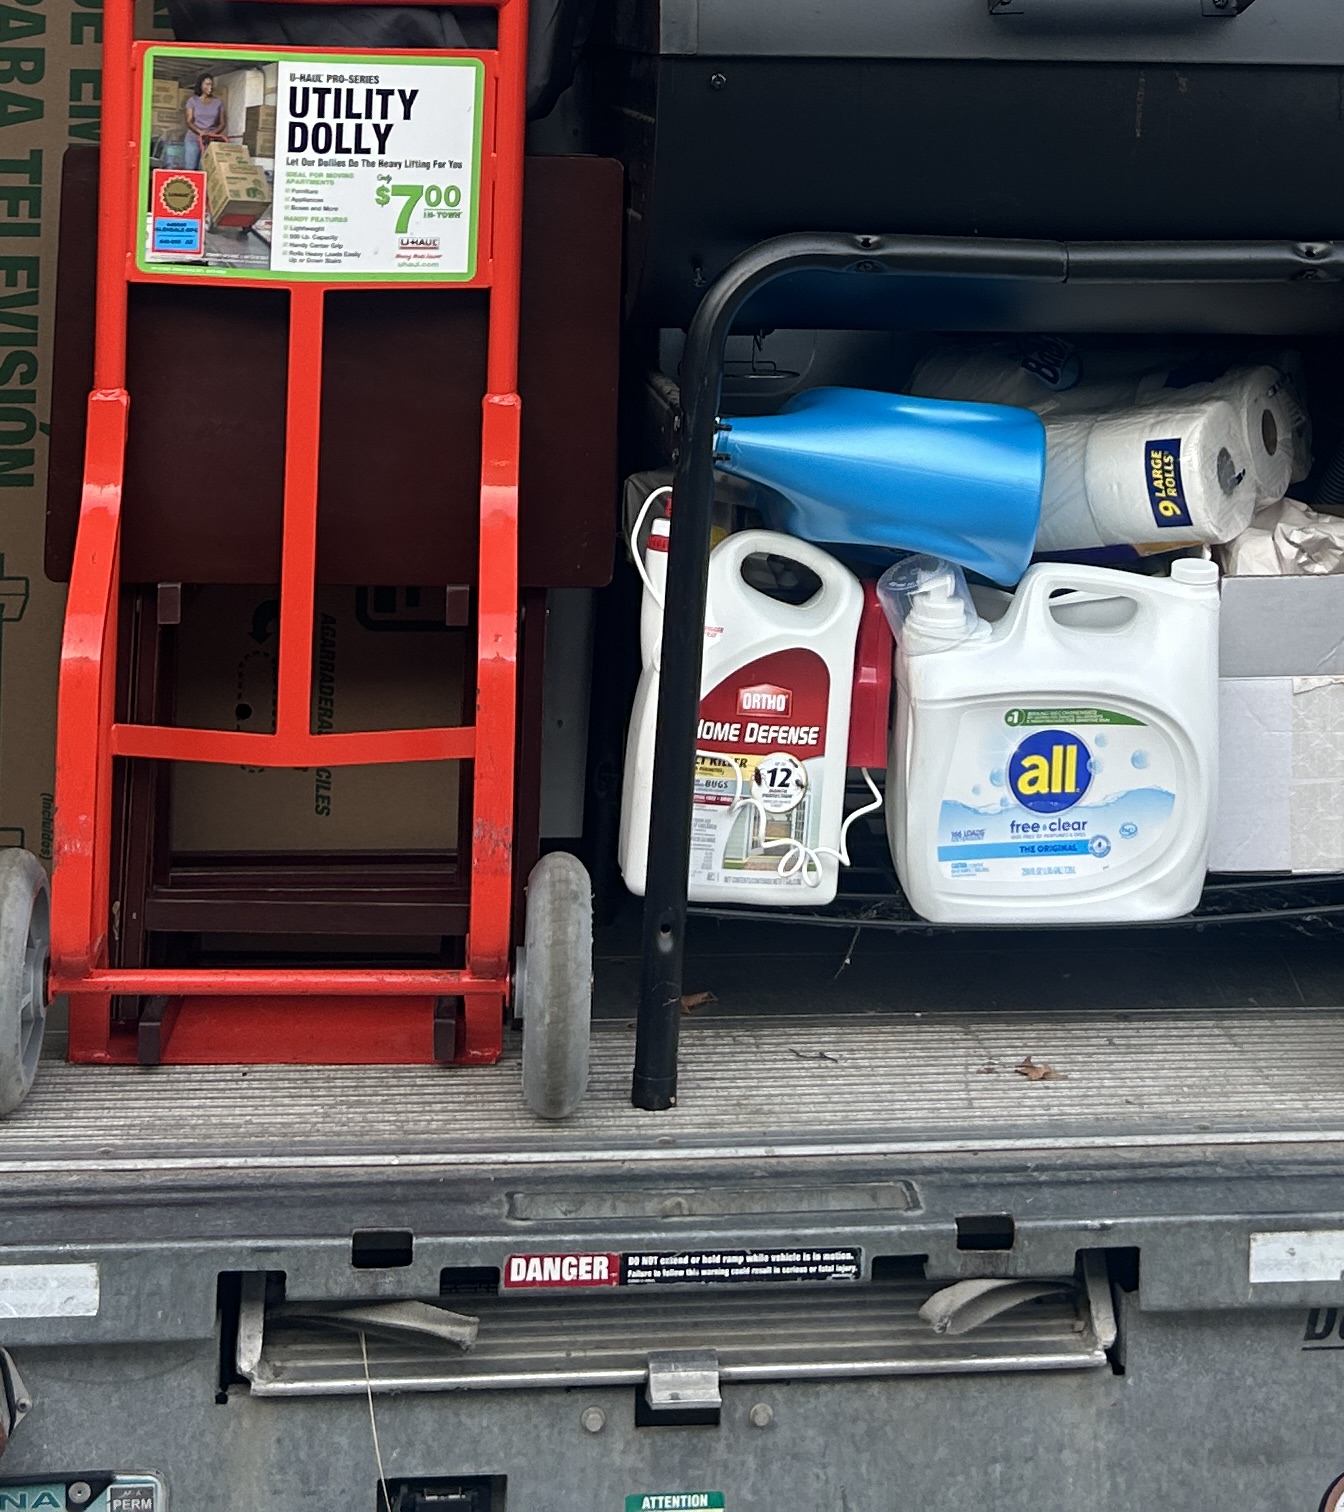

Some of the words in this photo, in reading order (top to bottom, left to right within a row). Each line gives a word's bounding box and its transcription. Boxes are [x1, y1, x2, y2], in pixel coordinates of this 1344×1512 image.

[327, 74, 379, 84] PRO-SERIES
[289, 86, 419, 120] UTILITY
[288, 121, 394, 154] DOLLY
[286, 157, 298, 166] Let
[301, 158, 315, 166] Our
[318, 158, 346, 167] Dollies
[349, 159, 358, 167] Do
[361, 159, 375, 168] The
[379, 160, 402, 170] Heavy
[405, 160, 430, 170] Lifting
[449, 161, 462, 169] You
[1152, 450, 1166, 498] LARGE
[1165, 452, 1176, 498] ROLLS
[1158, 498, 1182, 518] 9
[317, 613, 337, 735] AGARRADERA
[742, 692, 786, 711] ORTHO
[746, 722, 819, 745] DEFENSE
[766, 767, 792, 788] 12
[1018, 745, 1077, 795] all
[705, 779, 728, 789] BUGS
[1010, 820, 1040, 834] free
[1049, 818, 1088, 832] clear
[1019, 846, 1035, 854] THE
[628, 1256, 640, 1265] DO
[642, 1256, 658, 1265] NOT
[660, 1256, 688, 1265] extend
[702, 1255, 720, 1264] hold
[723, 1256, 743, 1265] ramp
[746, 1254, 769, 1263] while
[771, 1254, 801, 1263] vehicle
[803, 1254, 810, 1262] is
[813, 1253, 821, 1261] in
[823, 1252, 854, 1261] motion.
[510, 1256, 610, 1282] DANGER
[628, 1269, 652, 1278] Failure
[663, 1268, 684, 1277] follow
[686, 1268, 699, 1277] this
[701, 1268, 729, 1277] warning
[731, 1267, 749, 1276] could
[752, 1266, 771, 1275] result
[819, 1264, 834, 1273] fatal
[112, 1499, 152, 1511] PERM
[642, 1493, 708, 1510] ATTENTION
